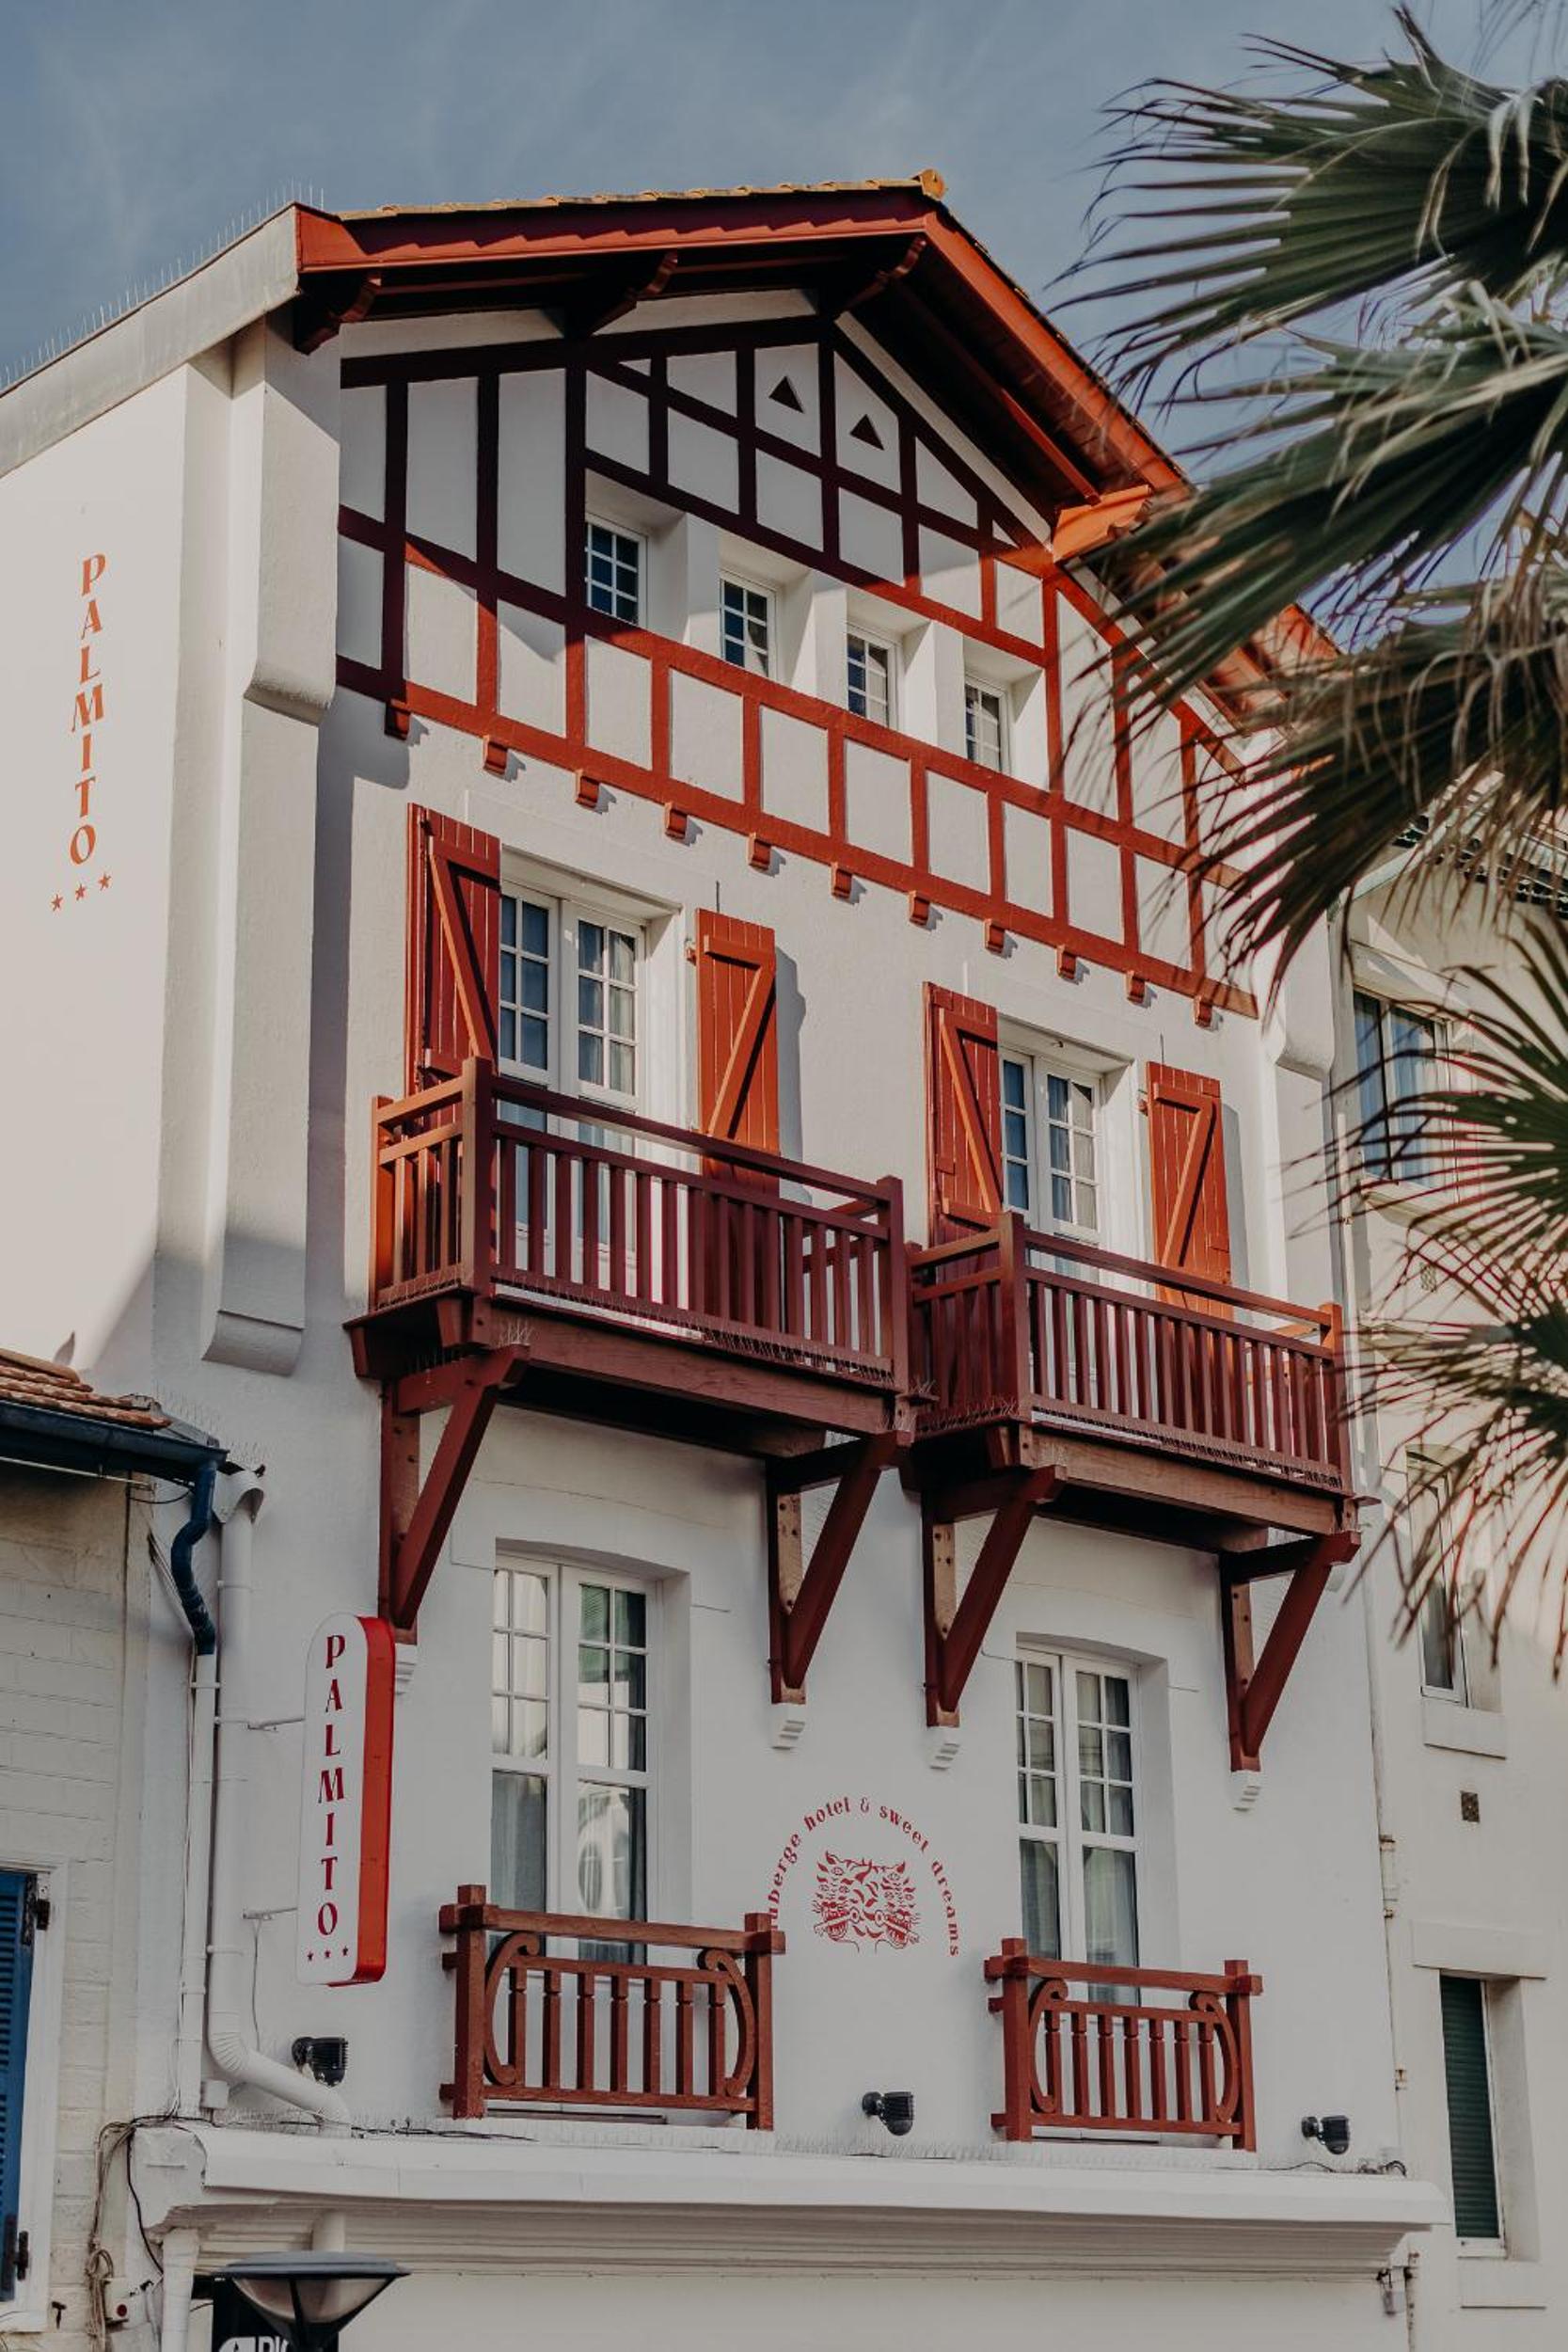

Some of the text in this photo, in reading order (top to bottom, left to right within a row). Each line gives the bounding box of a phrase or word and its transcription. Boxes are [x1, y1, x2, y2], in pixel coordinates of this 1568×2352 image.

[71, 553, 107, 866] PALMITO
[317, 1634, 346, 1936] PALMITO
[767, 1796, 960, 1958] uberge hotel & sweet dreams
